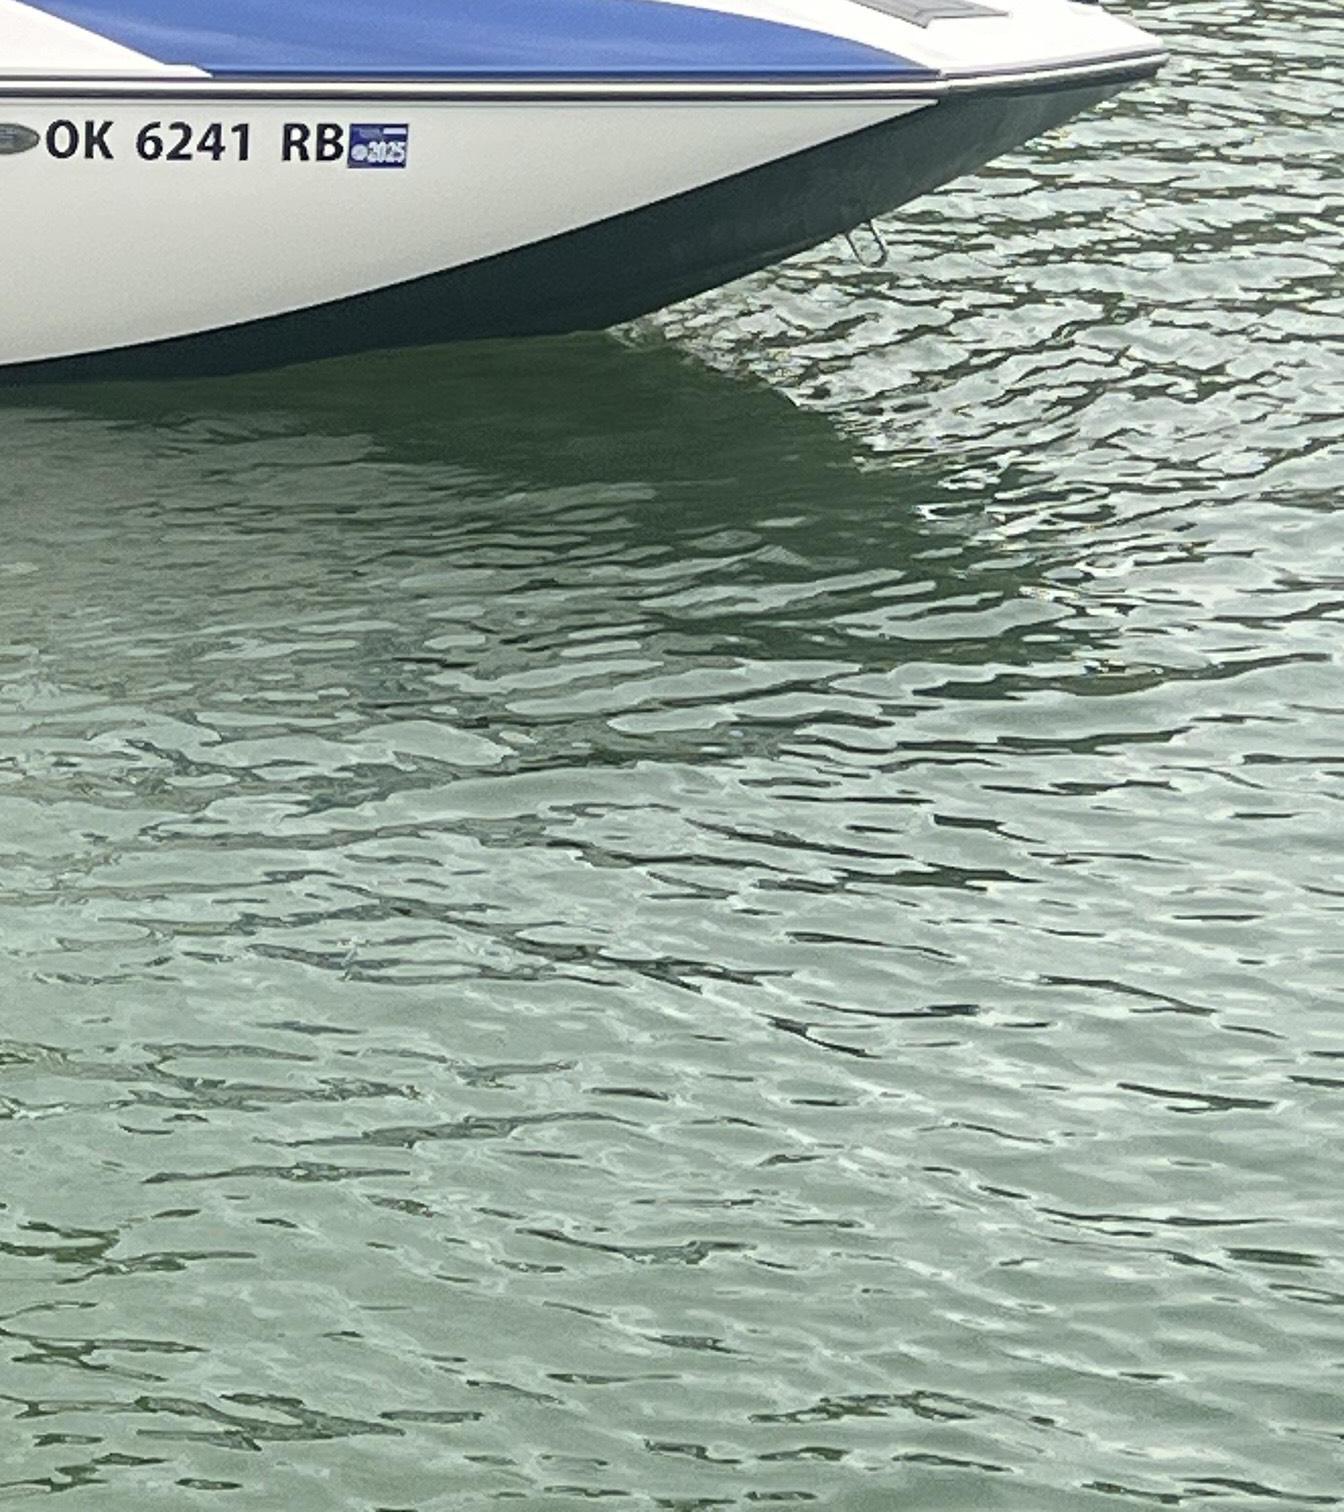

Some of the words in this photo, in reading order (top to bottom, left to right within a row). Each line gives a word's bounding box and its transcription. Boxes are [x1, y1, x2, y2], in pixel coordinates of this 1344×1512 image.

[45, 119, 114, 160] OK
[135, 121, 250, 161] 6241
[281, 123, 344, 162] RB
[367, 141, 406, 163] 2025
